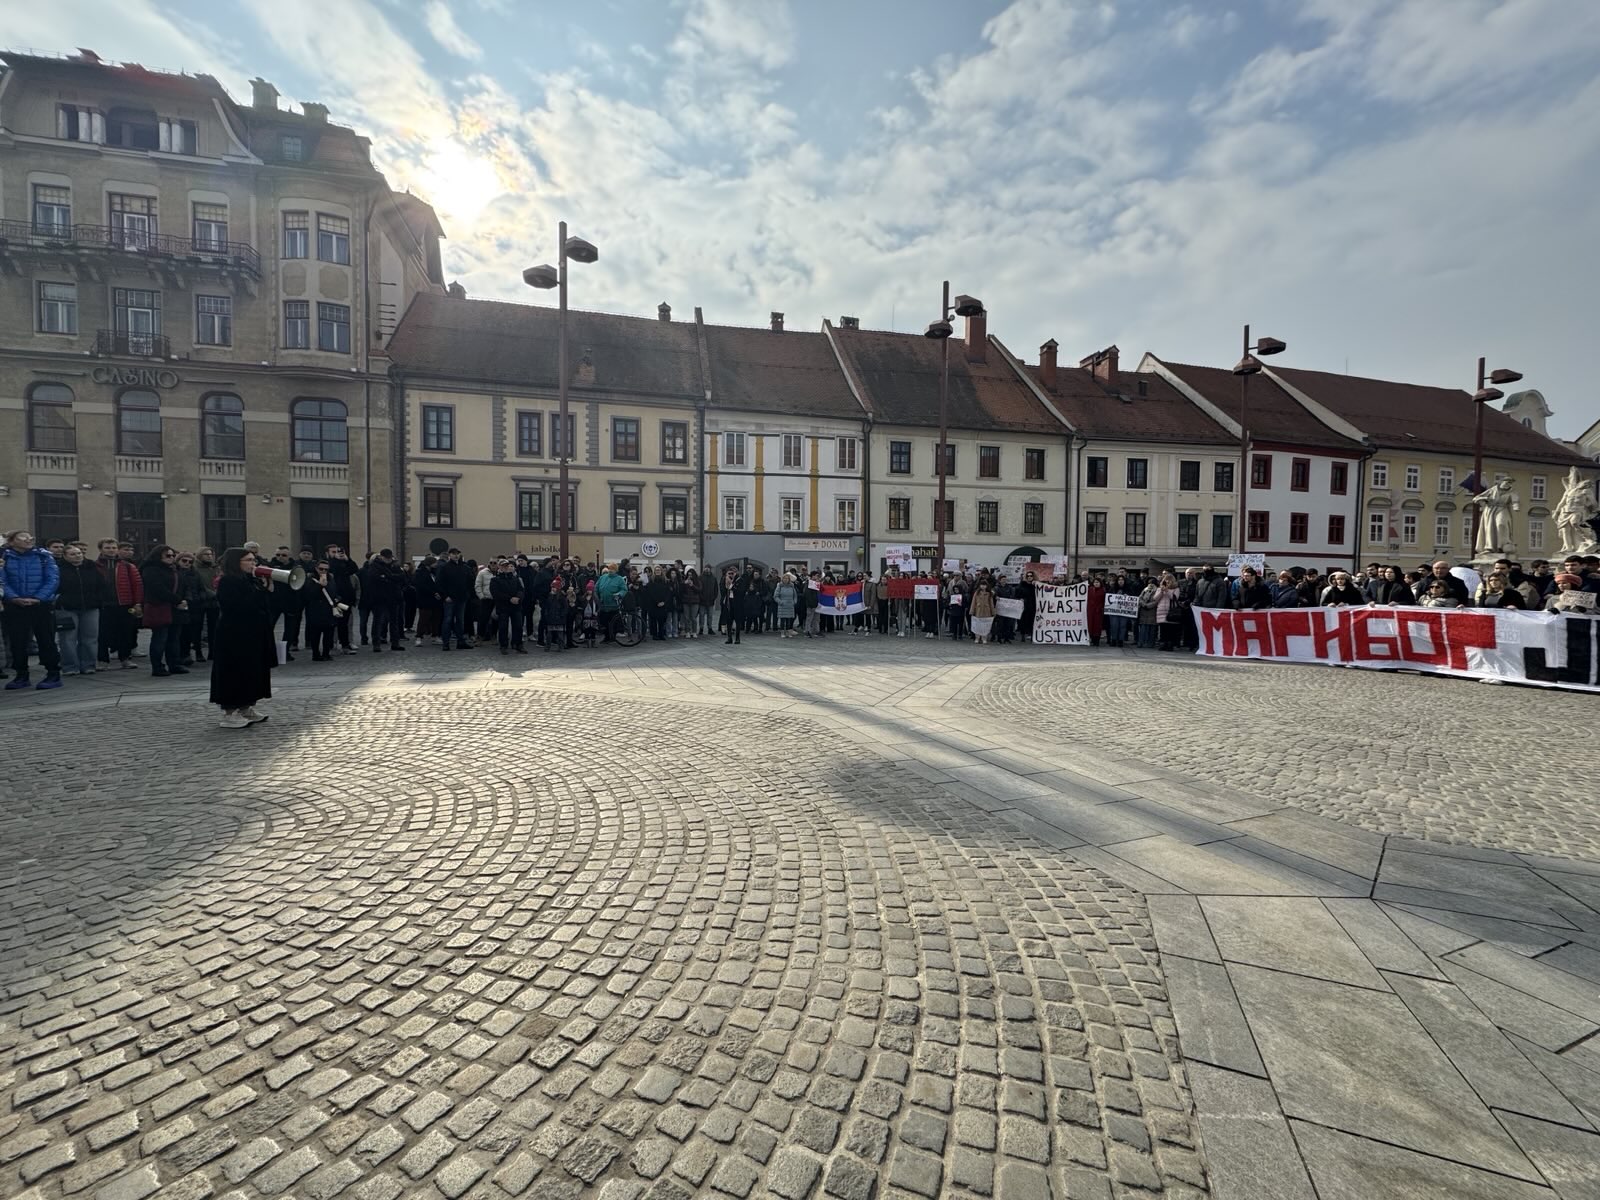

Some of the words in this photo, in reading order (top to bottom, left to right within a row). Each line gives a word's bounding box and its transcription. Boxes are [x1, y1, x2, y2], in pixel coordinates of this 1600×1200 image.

[91, 366, 179, 389] CASINO
[821, 540, 848, 549] DONAT
[1039, 599, 1086, 614] VLAST
[1035, 629, 1088, 643] USTAV!
